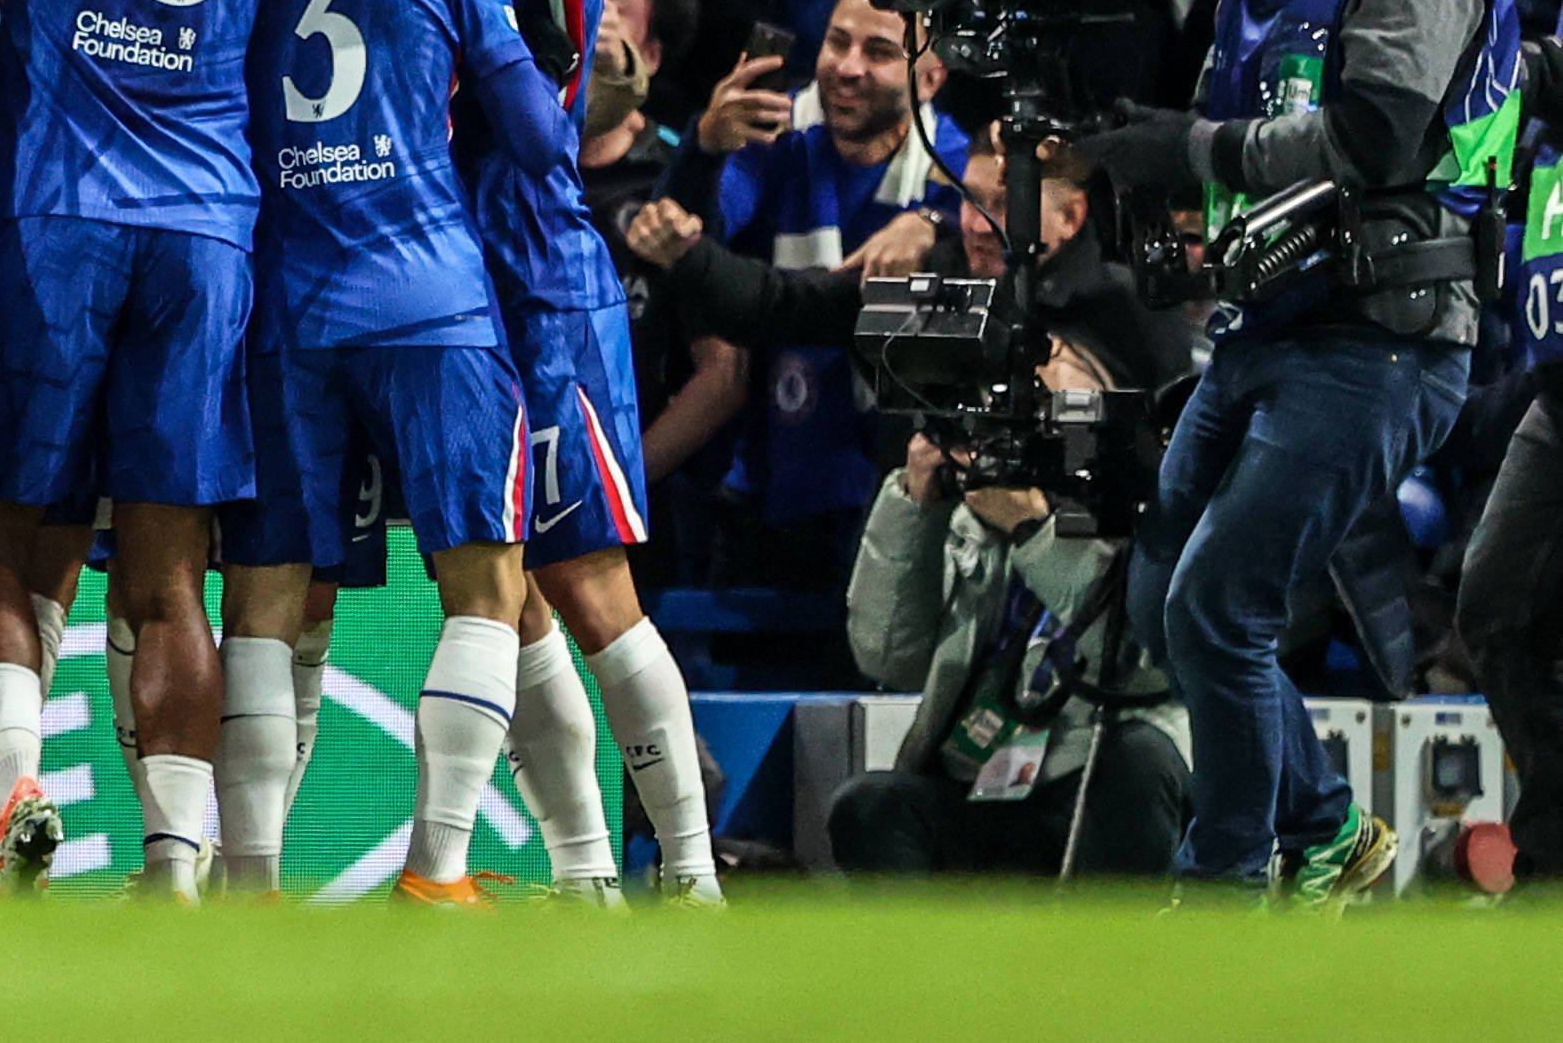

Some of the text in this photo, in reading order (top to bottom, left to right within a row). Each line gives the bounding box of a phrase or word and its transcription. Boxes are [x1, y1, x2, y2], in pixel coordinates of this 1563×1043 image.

[75, 9, 163, 46] Chelsea
[71, 30, 194, 73] Foundation
[278, 141, 361, 171] Chelsea
[279, 159, 397, 191] Foundation
